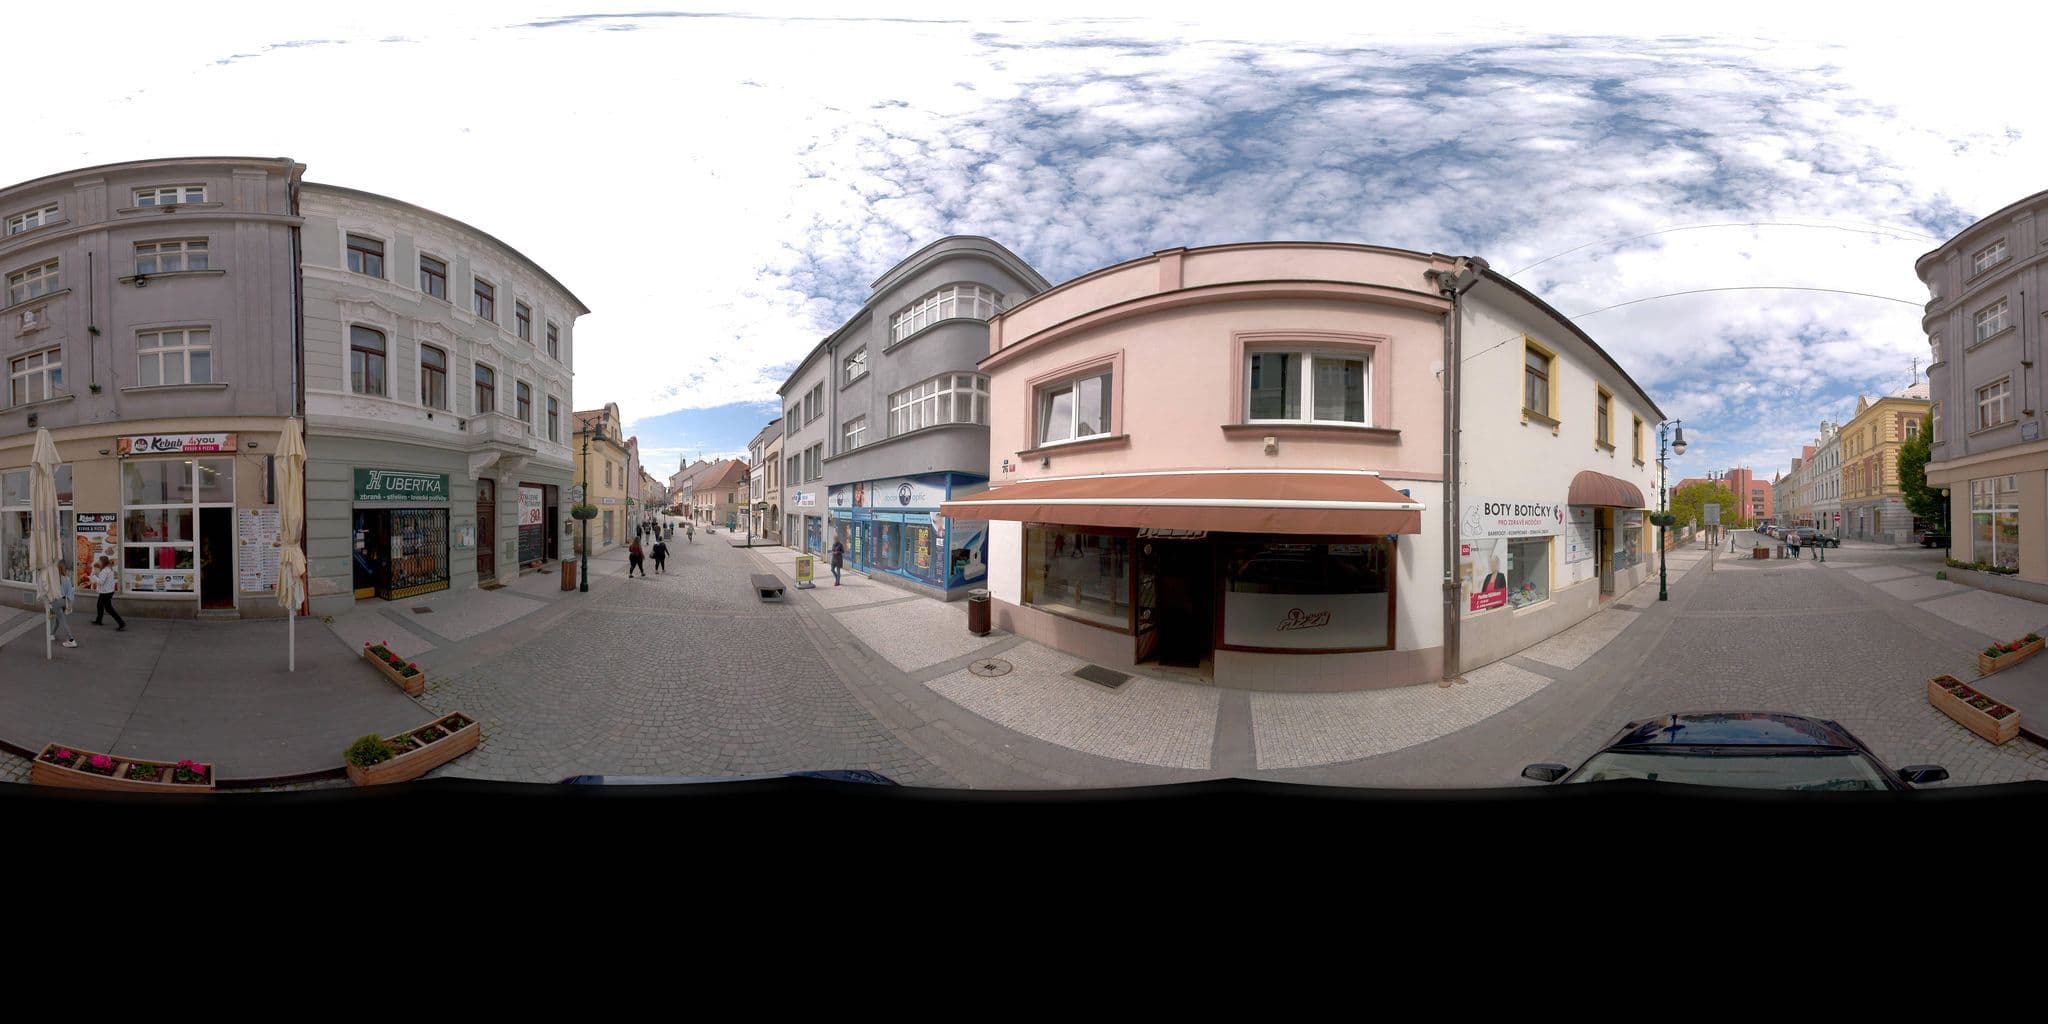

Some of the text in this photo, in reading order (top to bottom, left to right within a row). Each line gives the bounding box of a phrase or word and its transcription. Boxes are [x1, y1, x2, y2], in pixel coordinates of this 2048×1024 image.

[151, 437, 183, 451] Kebab
[1484, 503, 1551, 517] BOTY BOTIČKY
